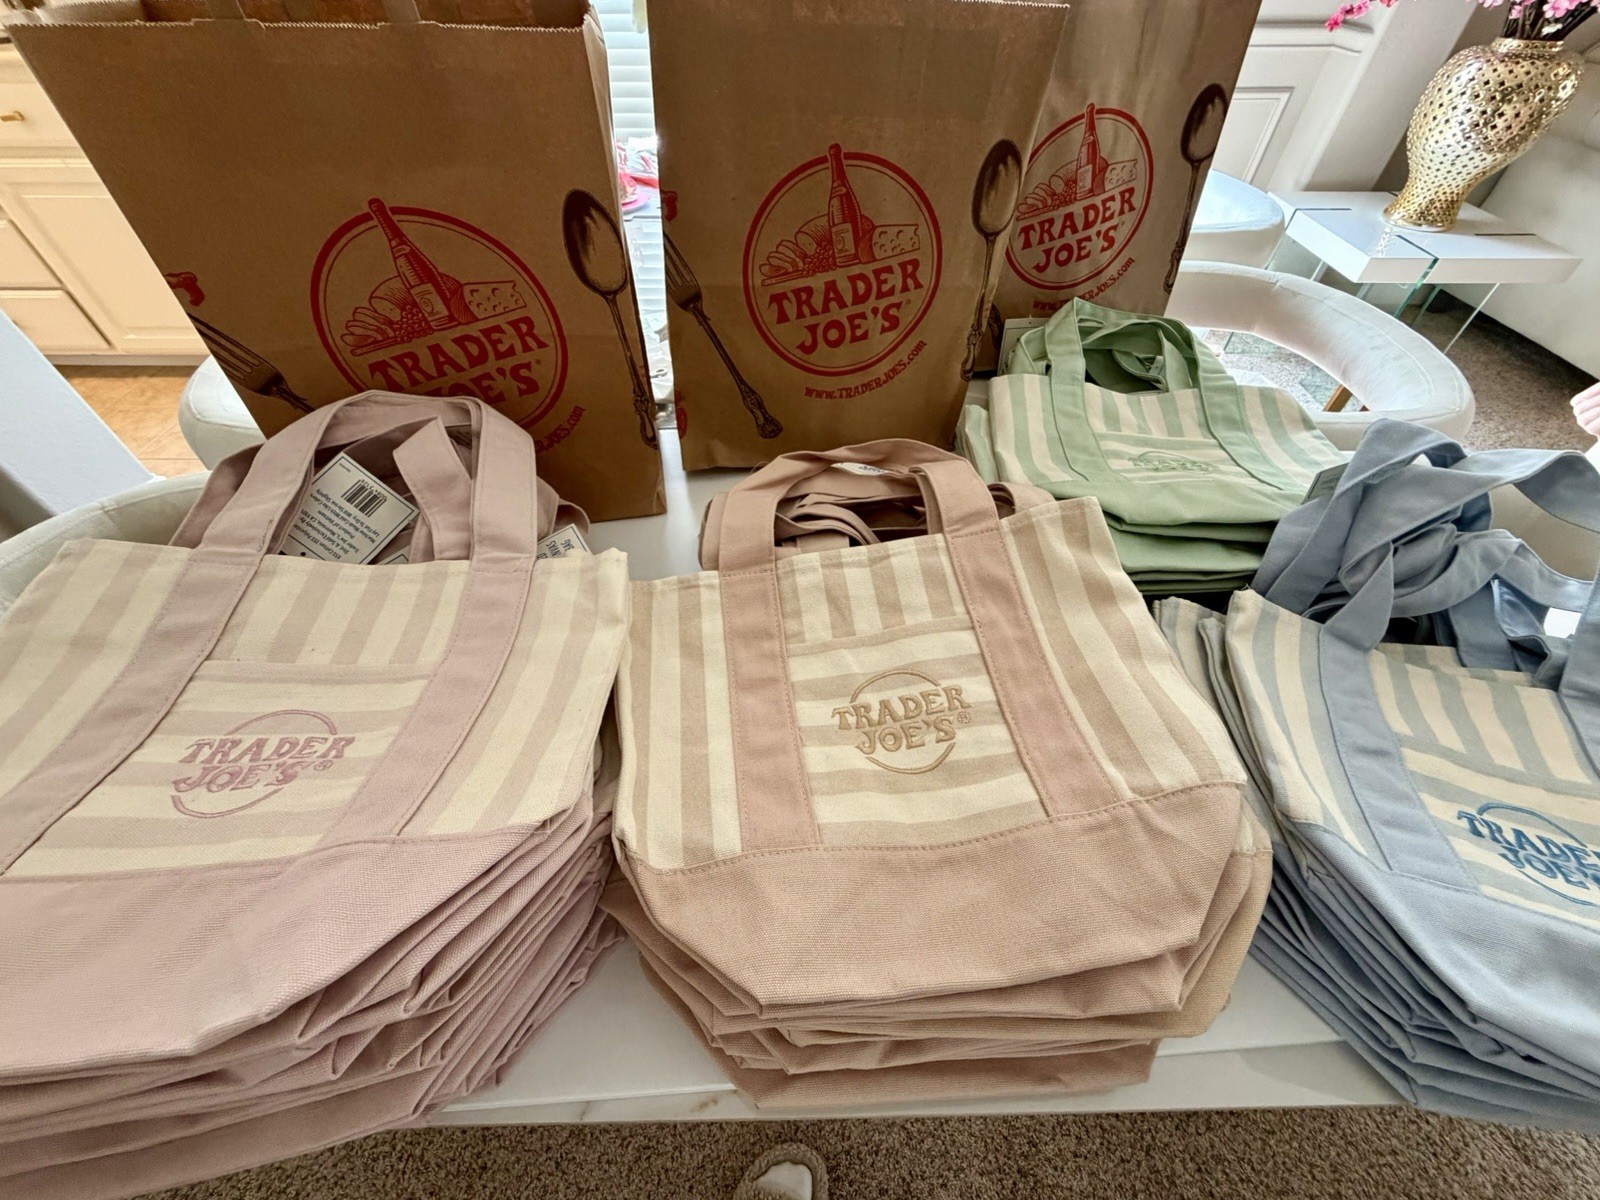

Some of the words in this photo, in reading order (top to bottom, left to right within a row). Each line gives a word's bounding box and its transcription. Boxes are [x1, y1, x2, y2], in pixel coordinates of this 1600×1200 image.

[1018, 186, 1136, 250] TRADER
[1032, 222, 1119, 273] JOE'S
[767, 257, 924, 325] TRADER
[368, 316, 549, 391] TRADER
[795, 301, 903, 355] JOE'S
[831, 684, 972, 730] TRADER
[178, 736, 356, 764] TRADER
[1457, 810, 1600, 872] TRADE
[1498, 845, 1600, 891] JOE'
